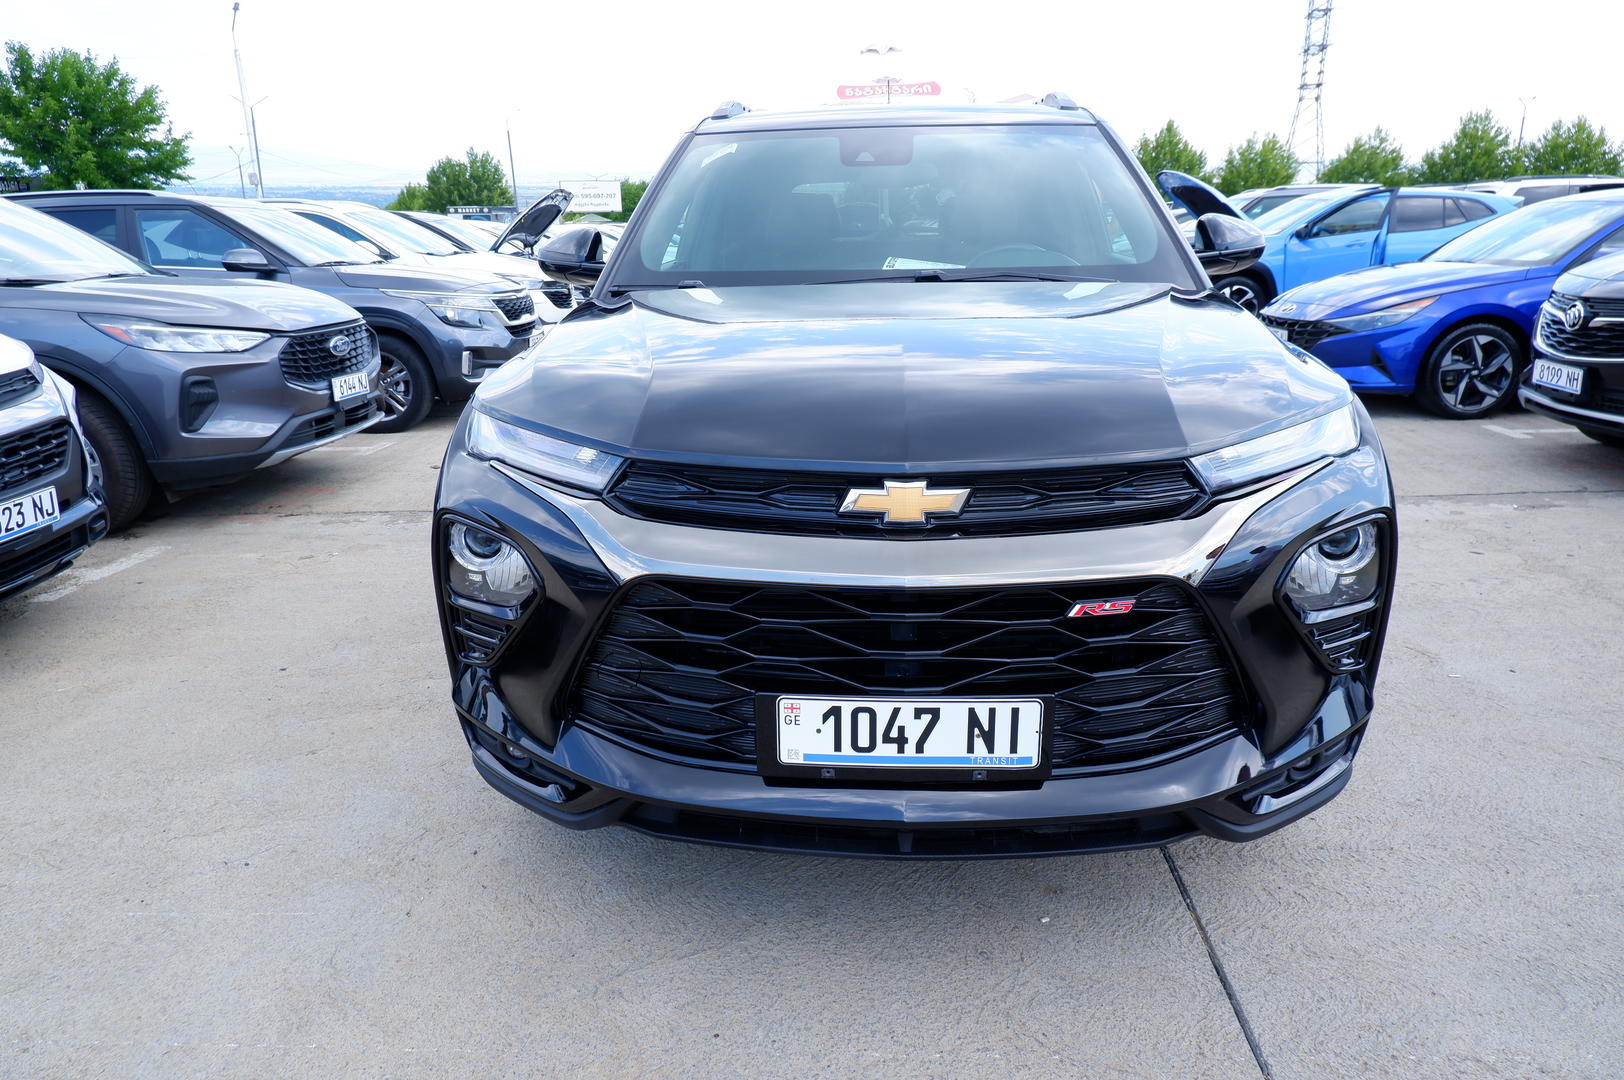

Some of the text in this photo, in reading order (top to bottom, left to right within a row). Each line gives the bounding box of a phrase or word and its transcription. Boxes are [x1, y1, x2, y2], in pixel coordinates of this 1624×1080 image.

[340, 374, 368, 395] 6144 NJ
[1539, 364, 1580, 389] 8199 NH
[0, 491, 56, 533] 23 NJ
[1068, 600, 1137, 617] RS
[784, 714, 801, 726] GE
[822, 705, 1020, 755] 1047 NI
[970, 756, 1018, 765] TRANSIT
